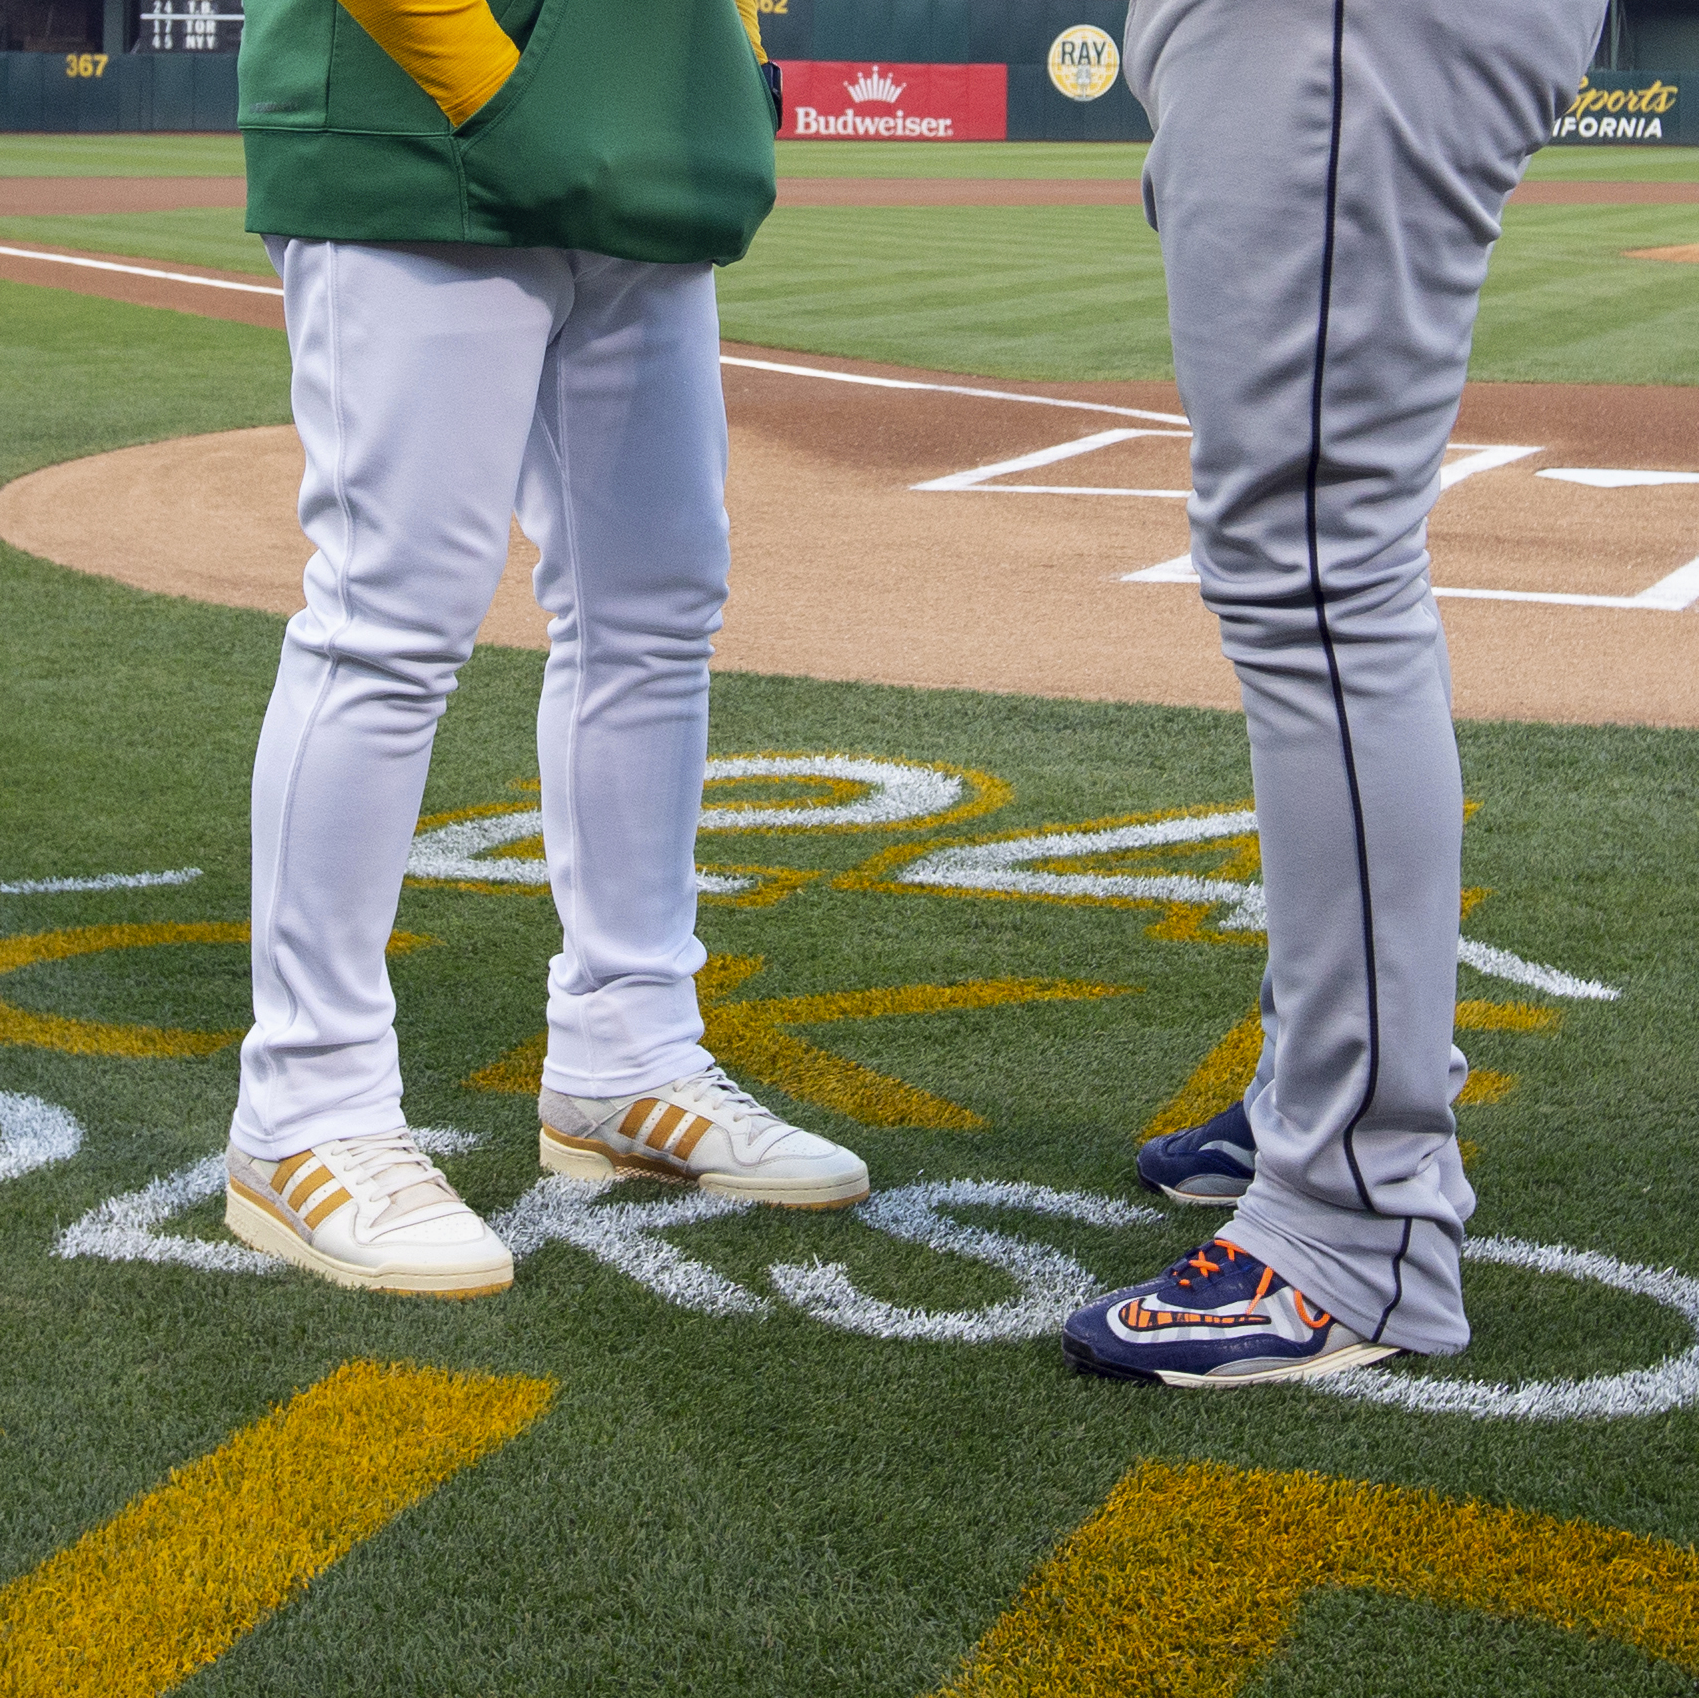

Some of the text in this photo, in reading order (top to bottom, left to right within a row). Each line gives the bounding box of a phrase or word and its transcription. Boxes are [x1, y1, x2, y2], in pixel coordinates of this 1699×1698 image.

[186, 19, 216, 34] TOR
[185, 35, 216, 50] NYY
[1060, 40, 1108, 66] RAY
[65, 53, 109, 79] 367
[794, 106, 954, 138] Budweiser
